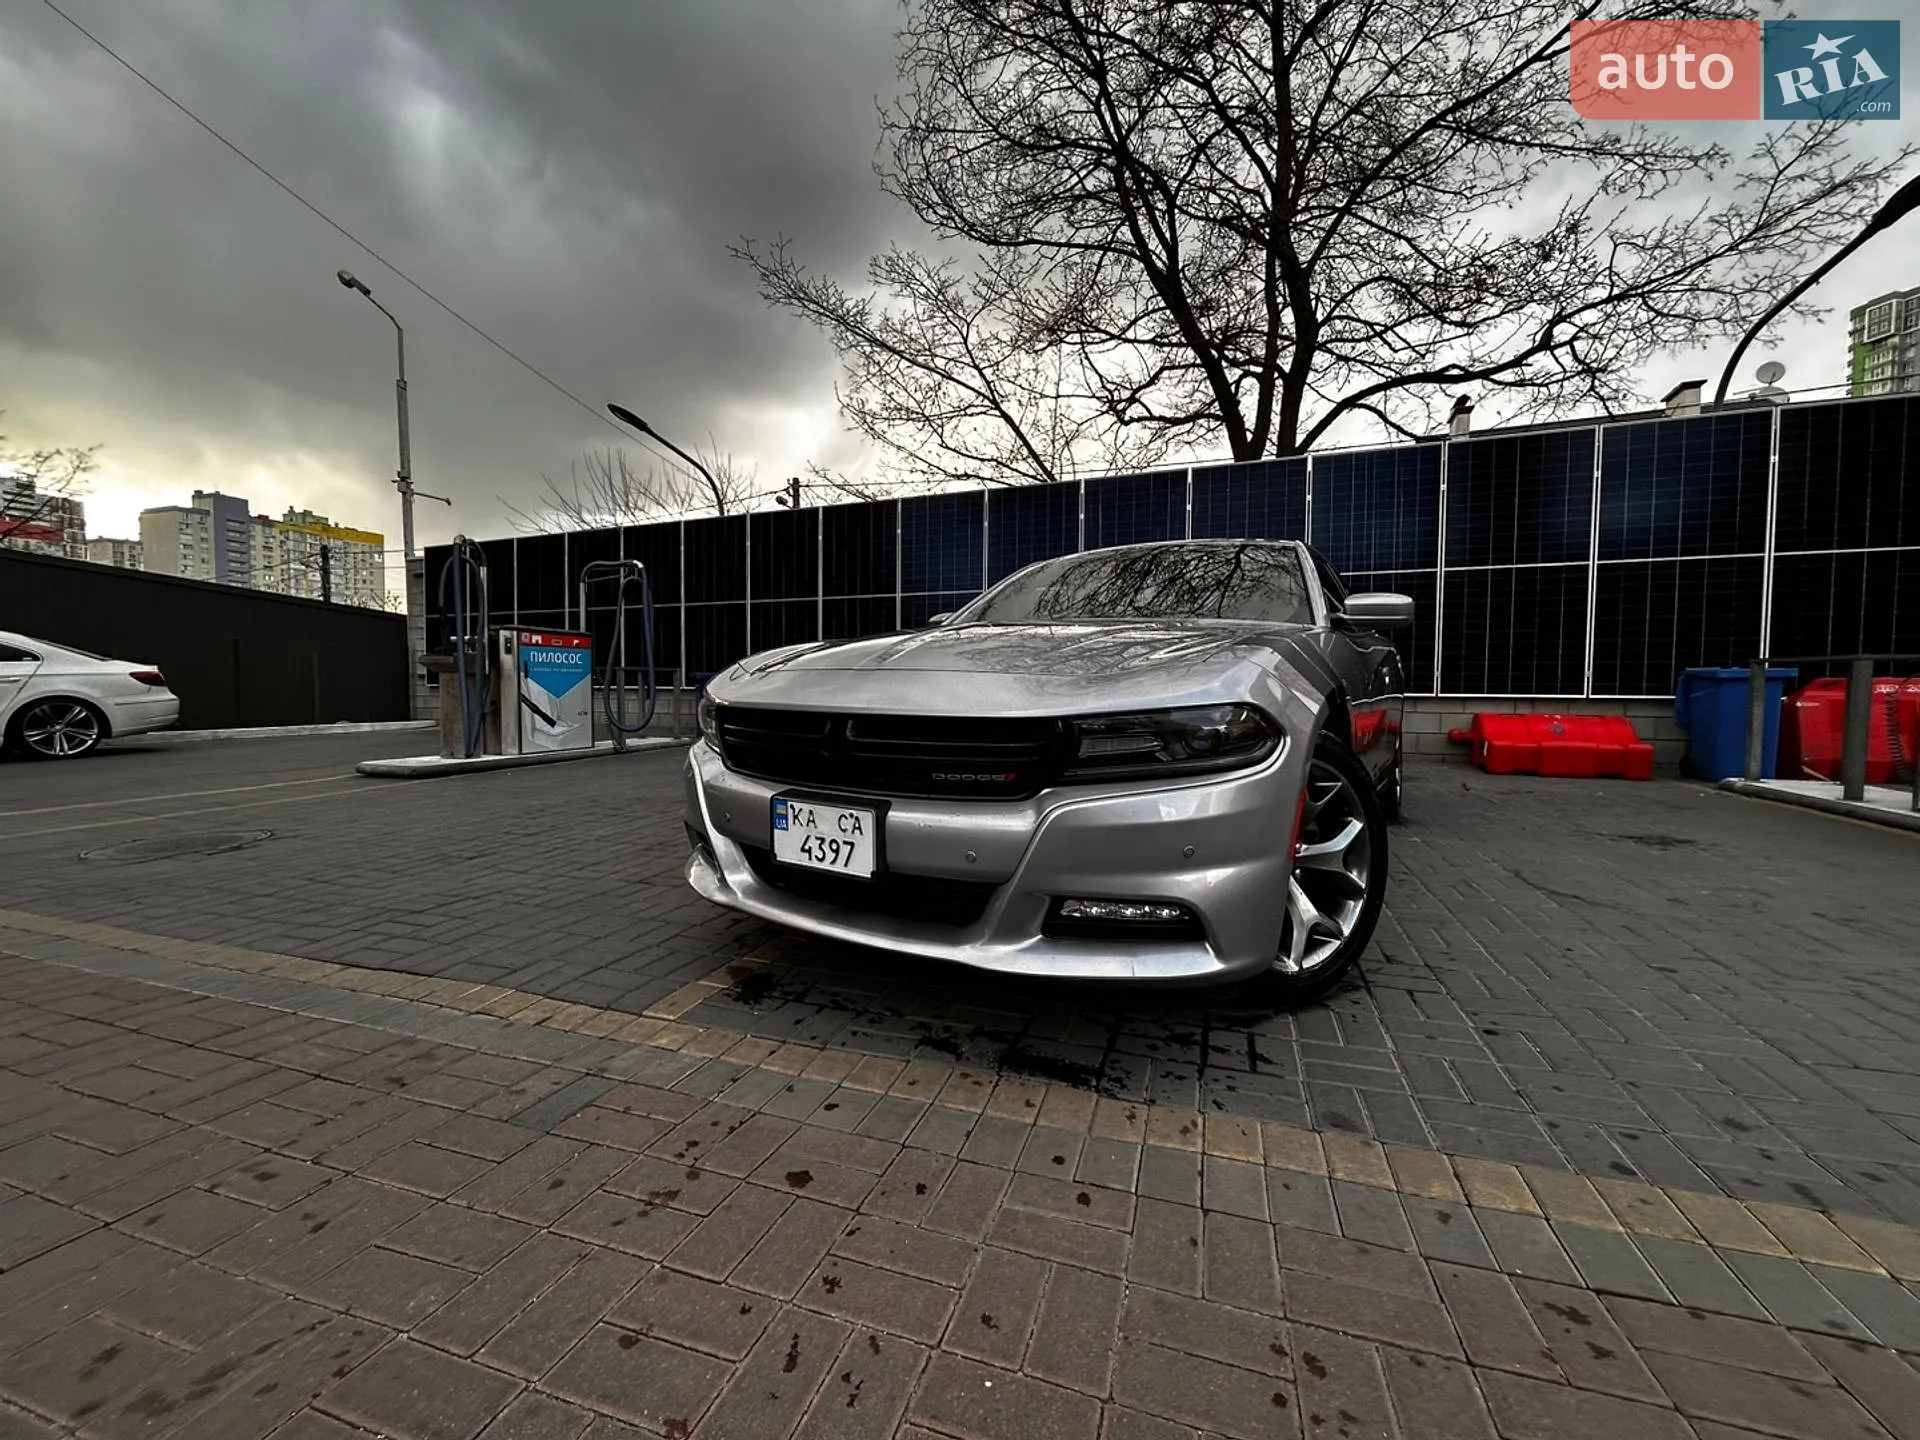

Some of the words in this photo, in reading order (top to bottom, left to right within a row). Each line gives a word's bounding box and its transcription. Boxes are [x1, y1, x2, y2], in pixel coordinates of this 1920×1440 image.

[530, 651, 583, 664] ПИЛОСОС
[932, 773, 1006, 781] DODGE
[776, 818, 788, 828] UA
[790, 803, 817, 829] KA
[837, 812, 863, 836] CA
[800, 835, 855, 867] 4397
